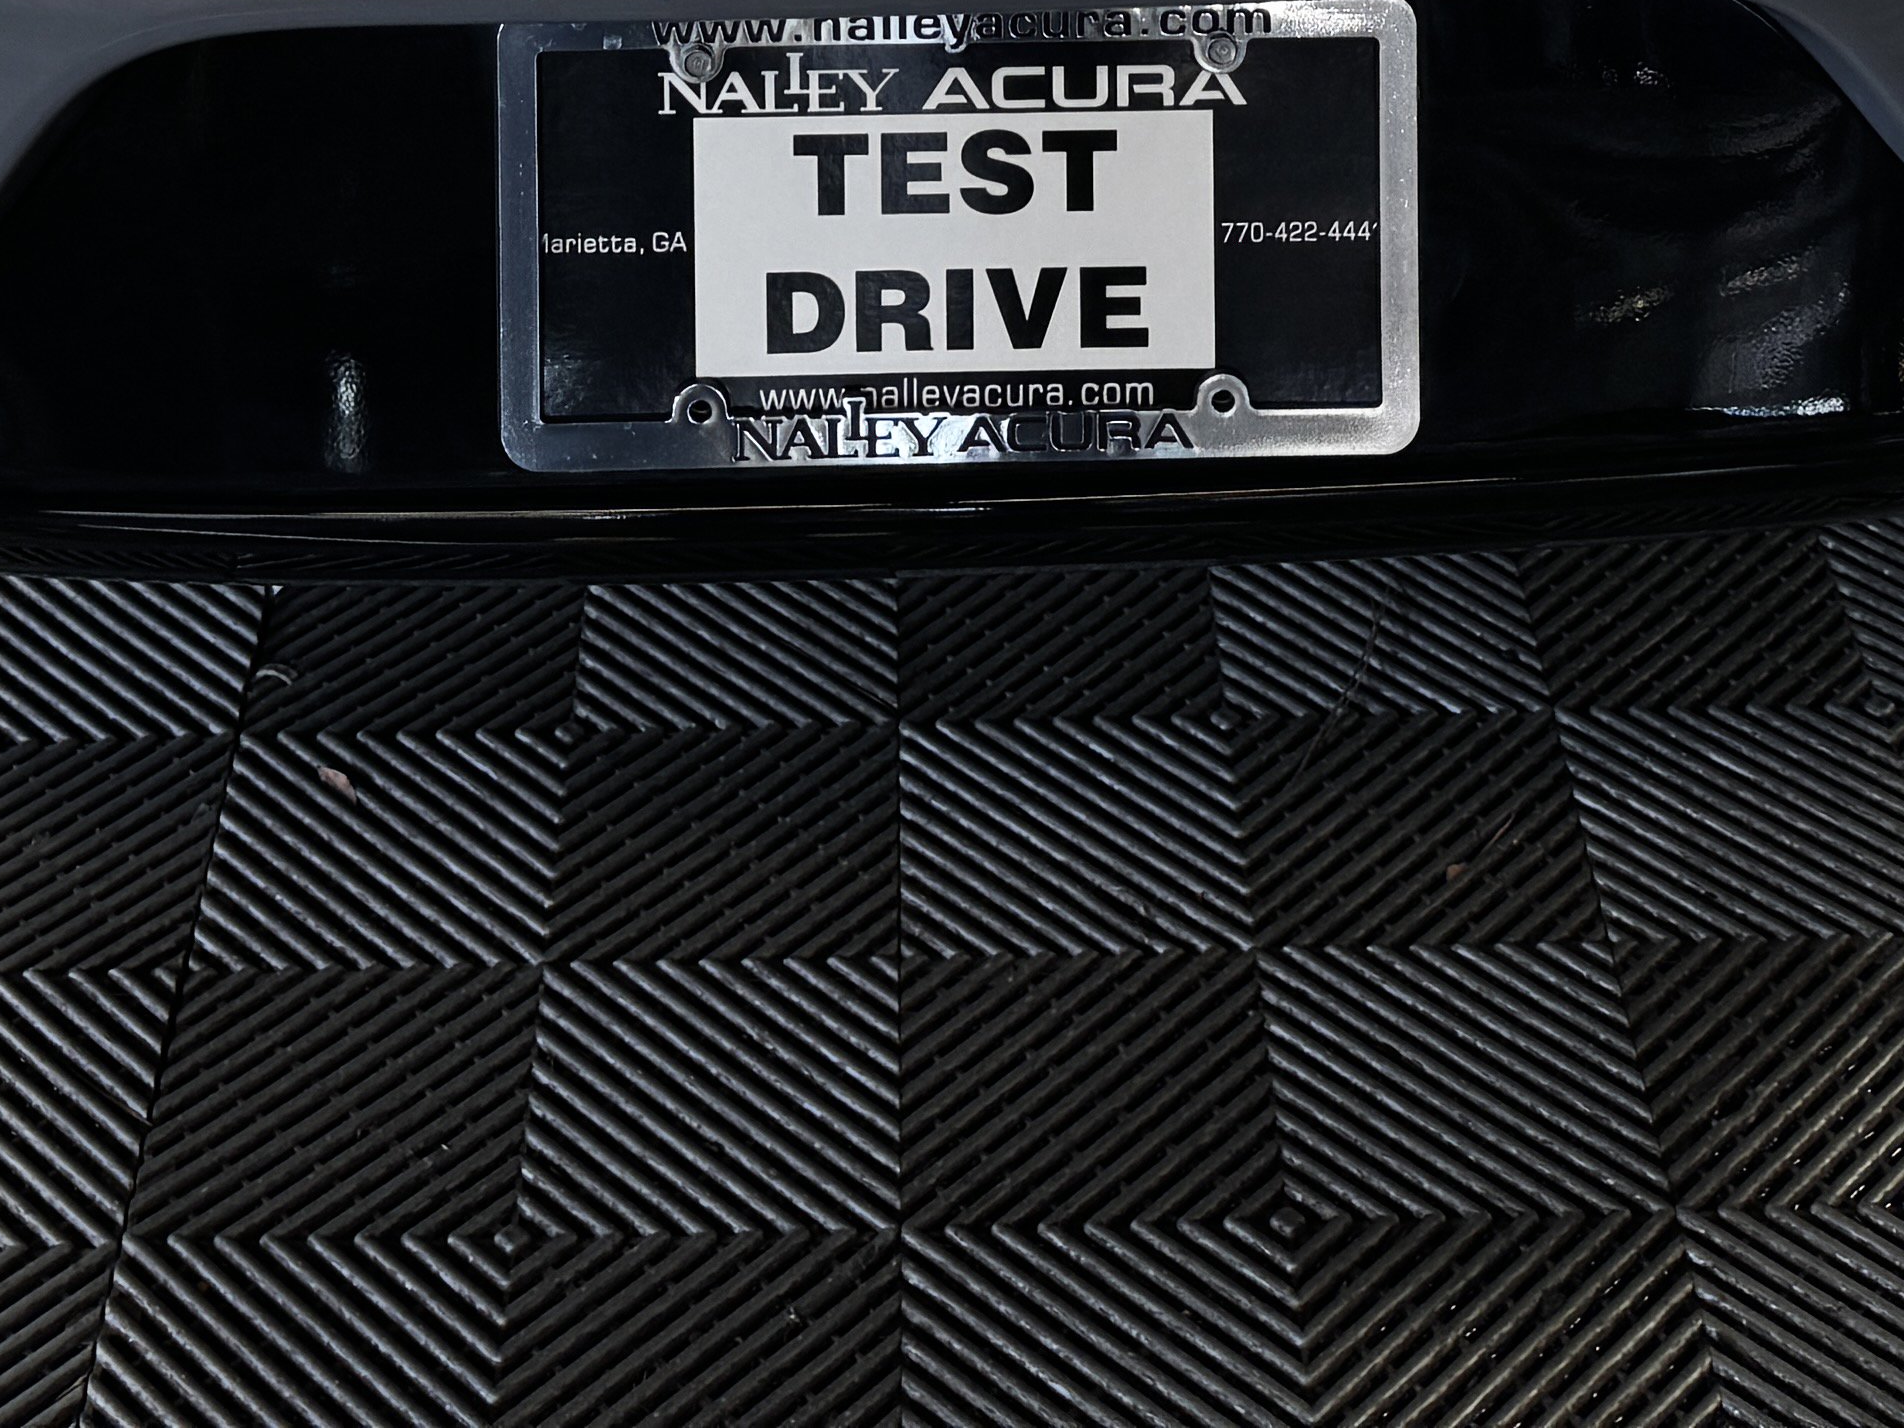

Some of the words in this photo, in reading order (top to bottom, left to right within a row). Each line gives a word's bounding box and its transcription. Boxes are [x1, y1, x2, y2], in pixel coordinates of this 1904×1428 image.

[658, 52, 899, 115] NALLEY
[922, 64, 1248, 110] ACURA
[793, 129, 1118, 217] TEST
[652, 231, 687, 253] GA
[1221, 220, 1377, 243] 770-422-444
[765, 265, 1150, 357] DRIVE
[759, 377, 1154, 410] wwwnalleyacura.com
[732, 397, 947, 462] NALLEY
[957, 410, 1194, 454] ACURA
